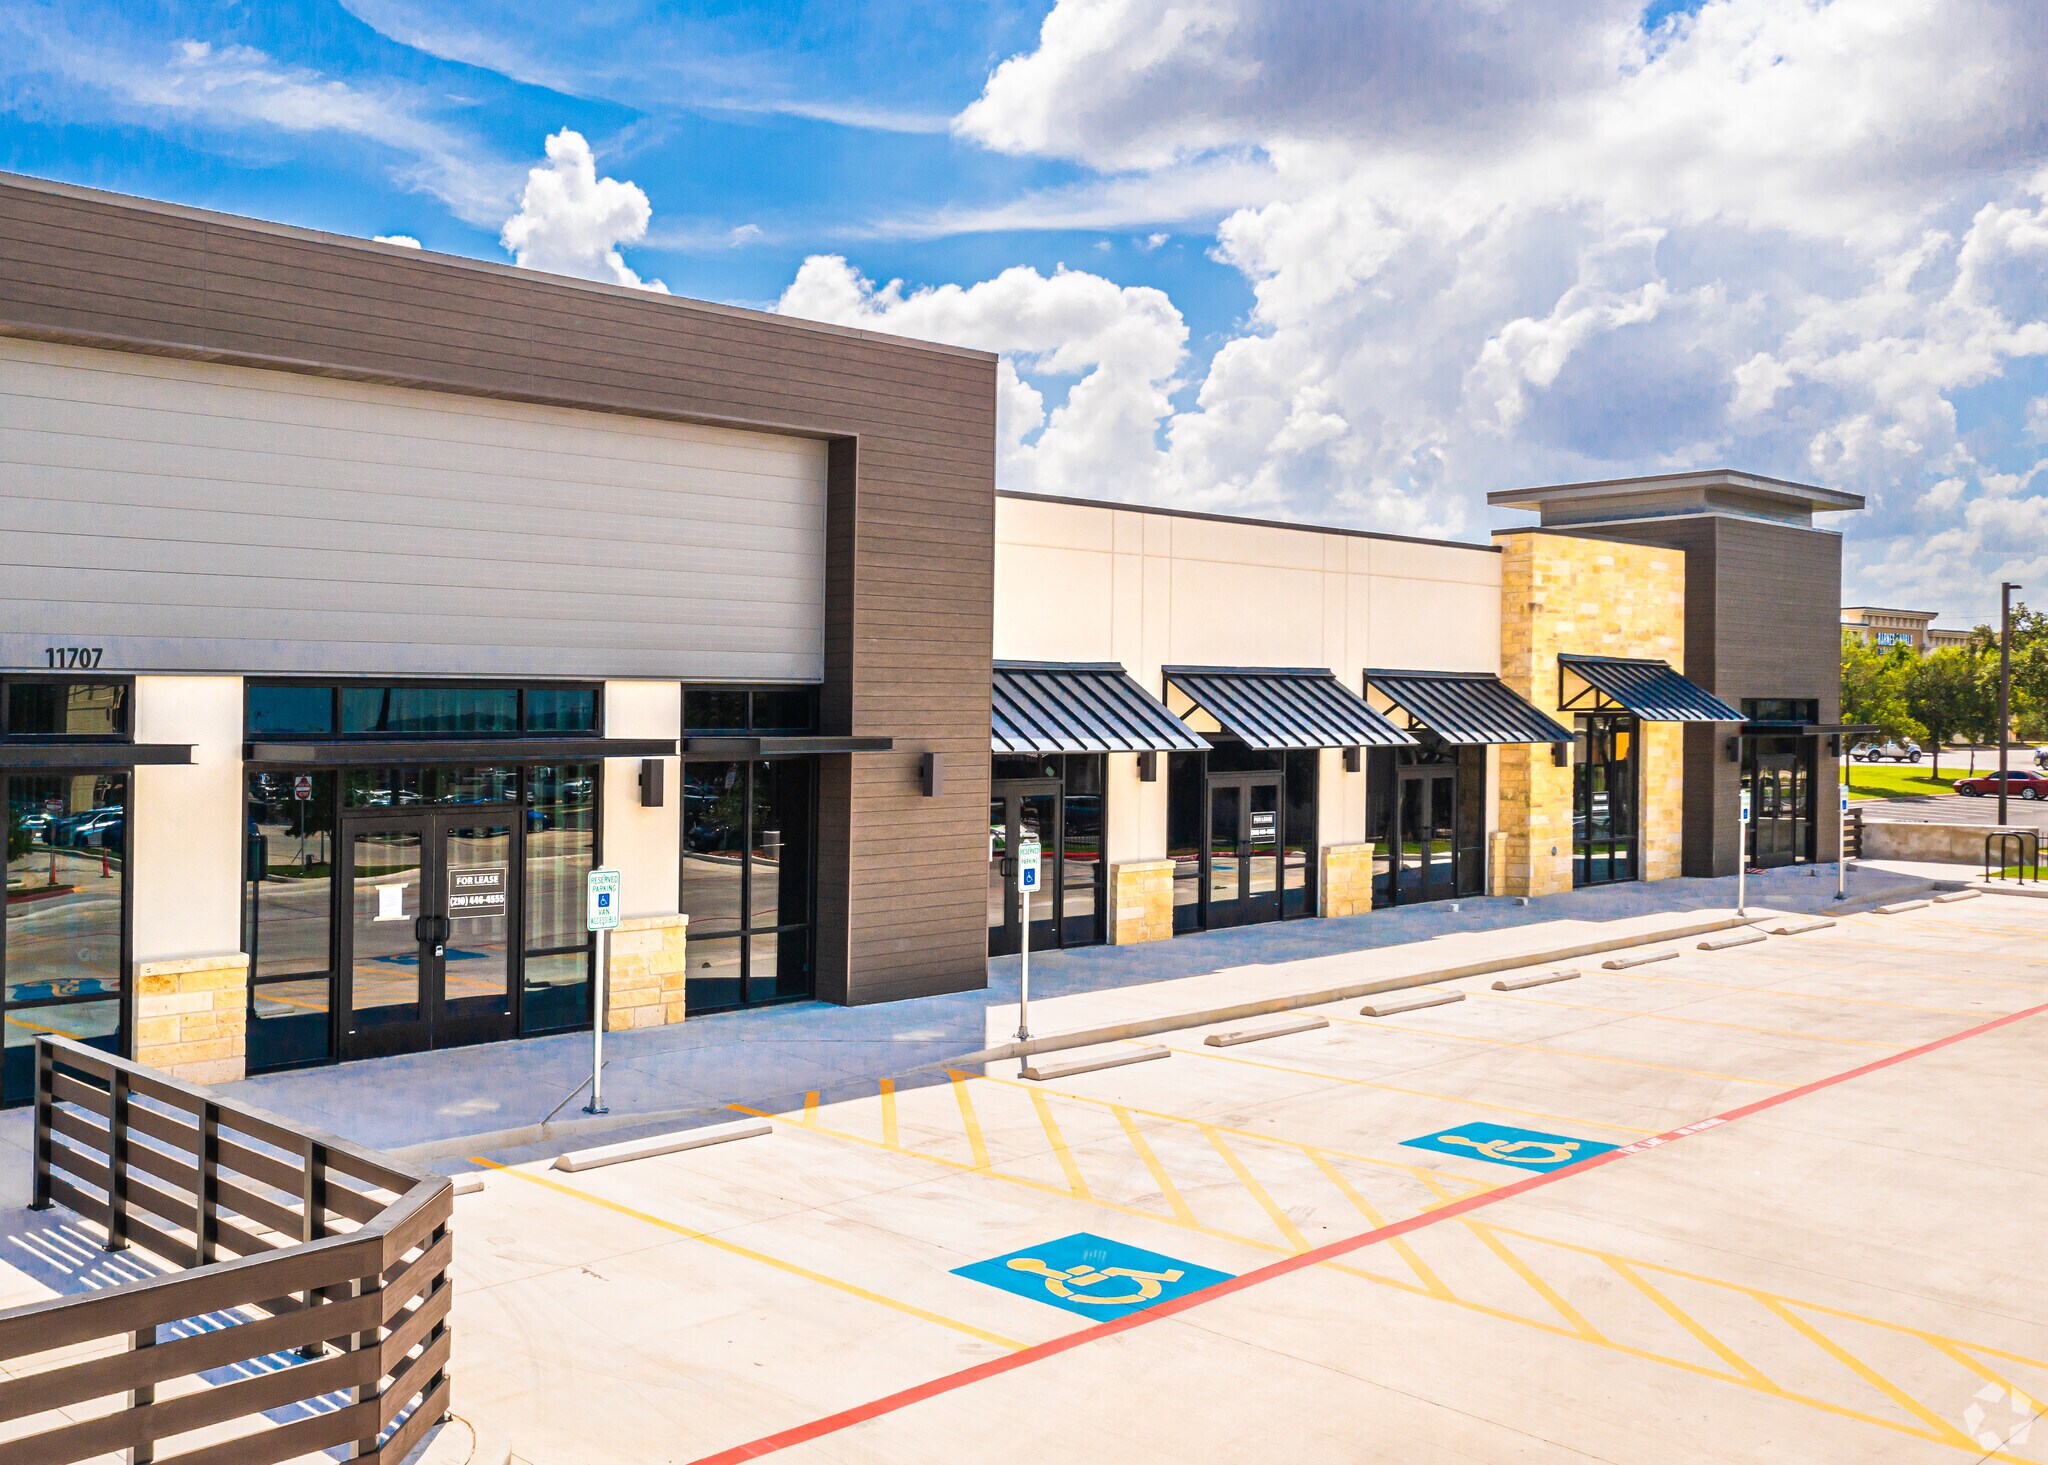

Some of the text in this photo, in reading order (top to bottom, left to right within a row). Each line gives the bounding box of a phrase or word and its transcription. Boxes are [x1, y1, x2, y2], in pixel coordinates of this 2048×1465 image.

[45, 647, 103, 669] 11707
[456, 875, 499, 886] FOR LEASE
[590, 875, 619, 884] RESERVED
[592, 884, 617, 892] PARKING
[450, 896, 468, 907] (210)
[590, 916, 617, 925] ACCESSIBLE
